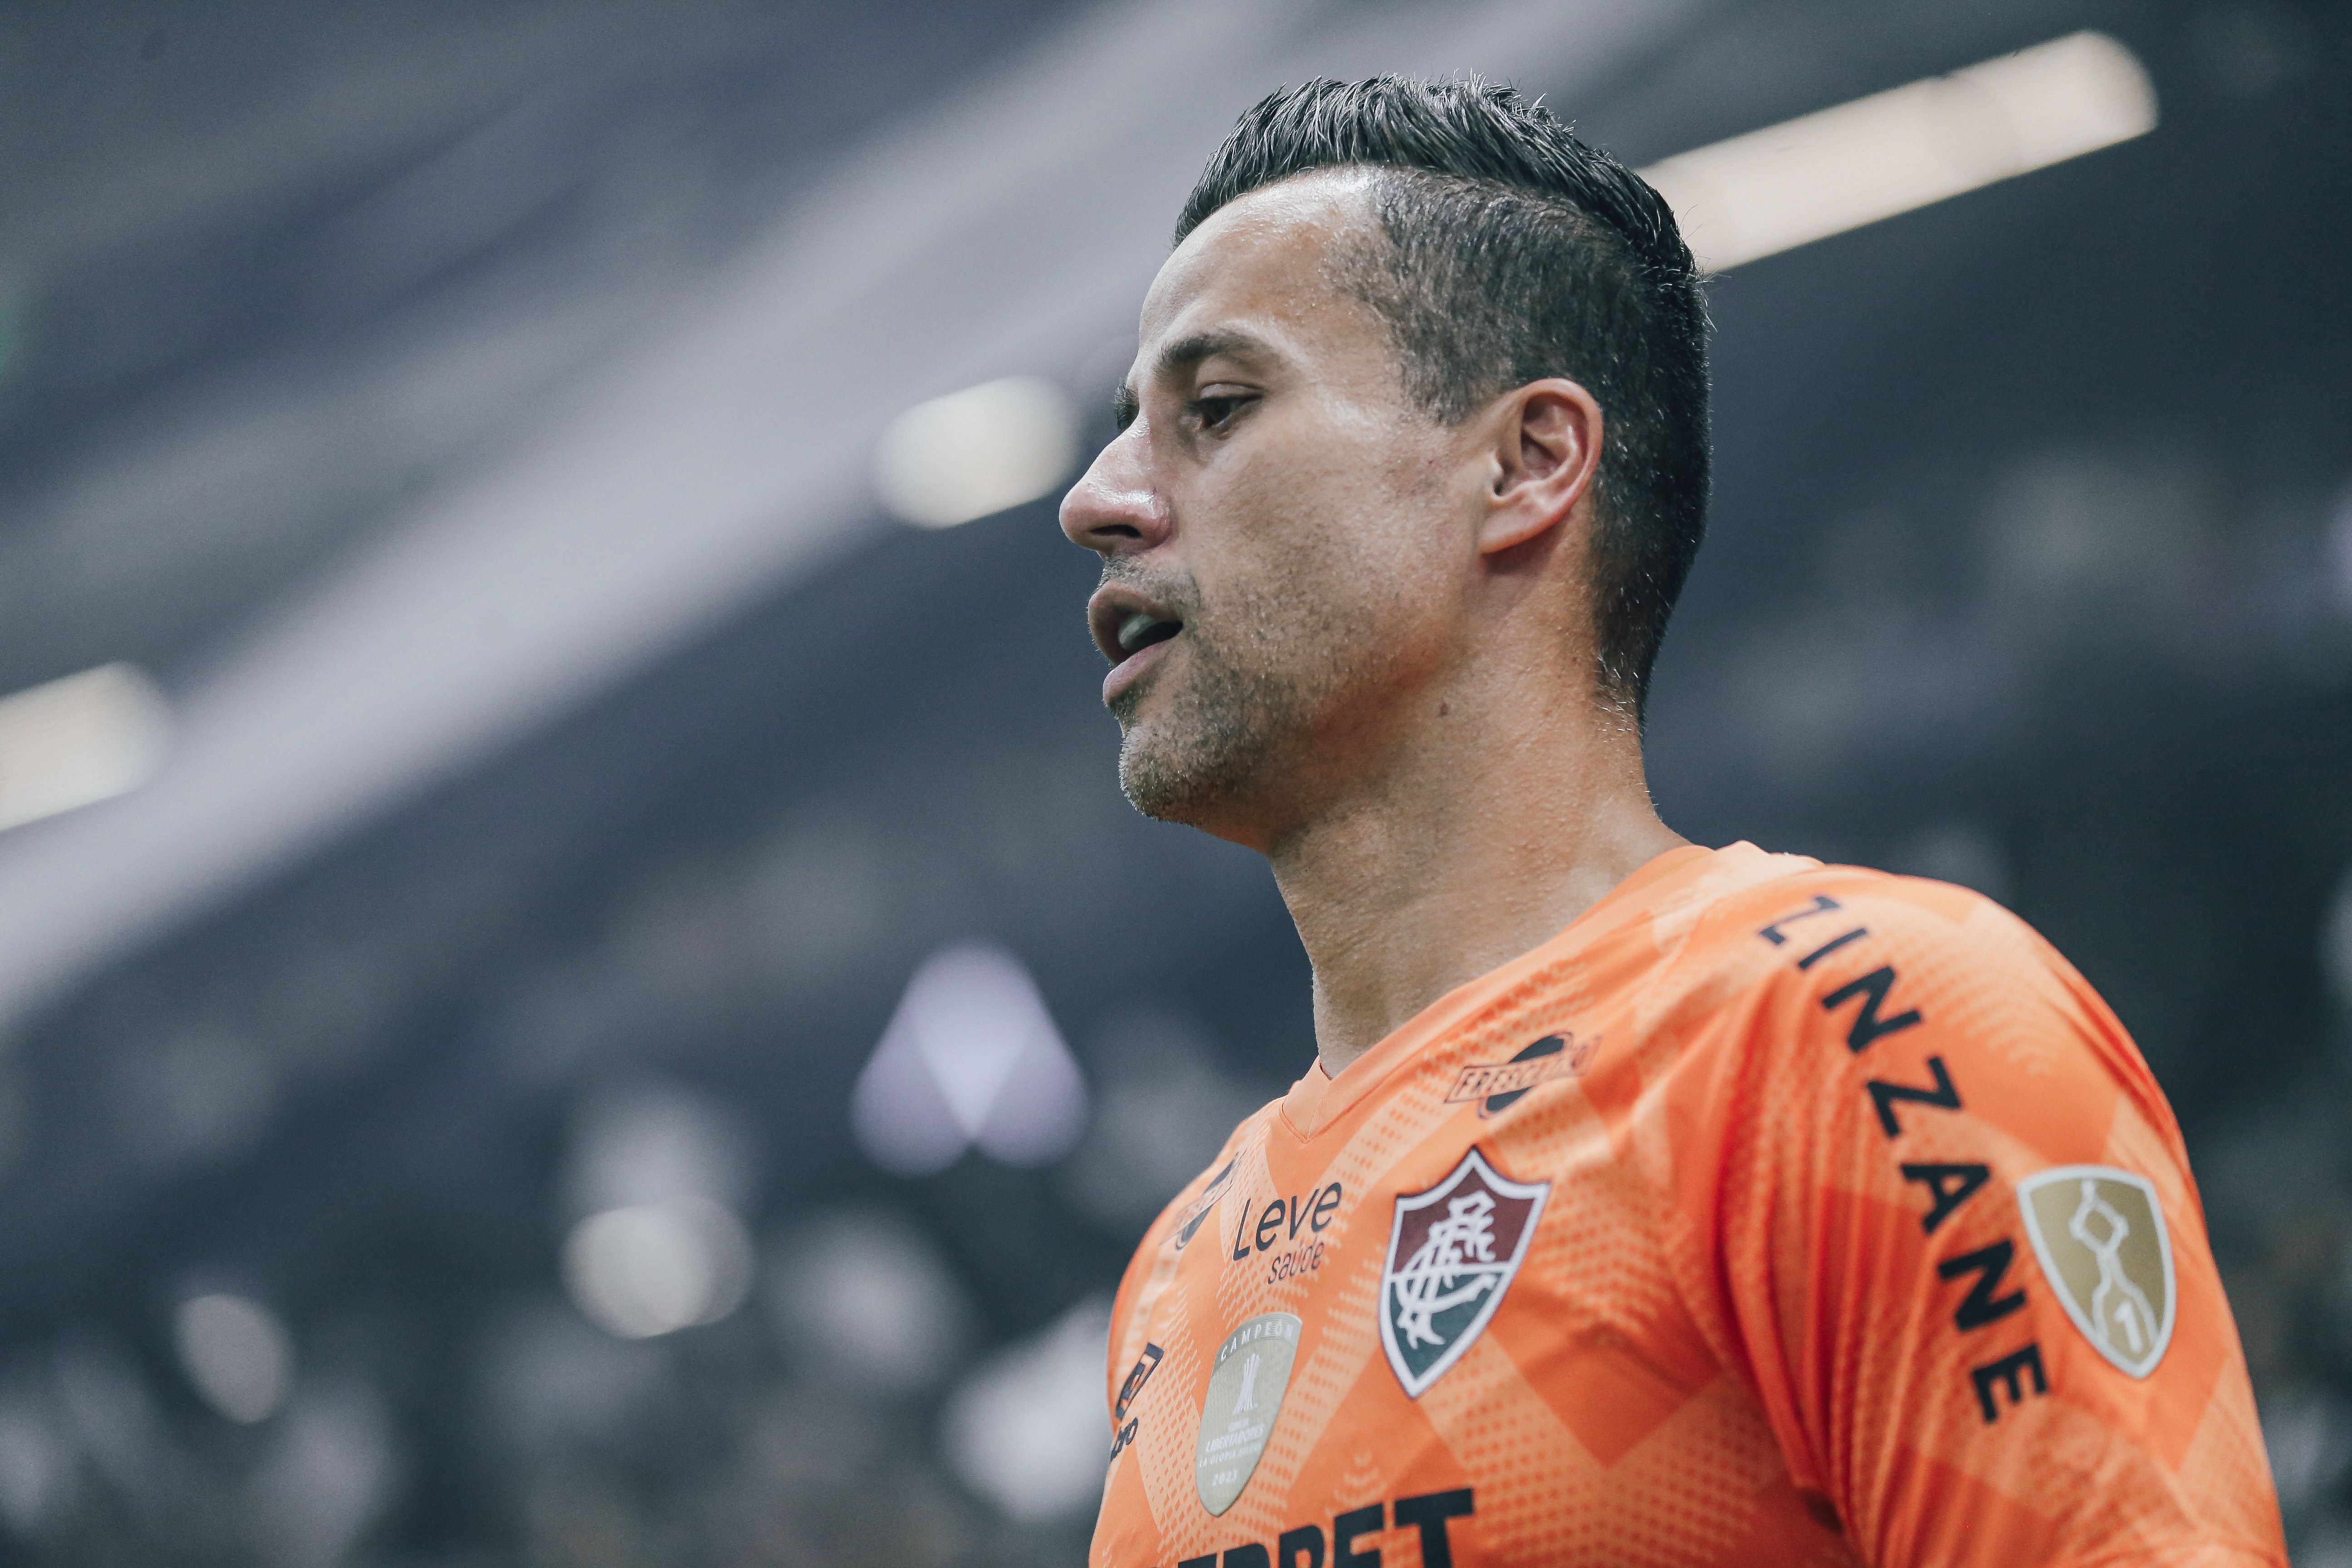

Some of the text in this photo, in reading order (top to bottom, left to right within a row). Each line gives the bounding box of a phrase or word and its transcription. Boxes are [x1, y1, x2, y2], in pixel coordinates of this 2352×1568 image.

[1757, 893, 2050, 1424] ZINZANE
[1233, 1181, 1342, 1262] Leve
[2114, 1301, 2143, 1352] 1
